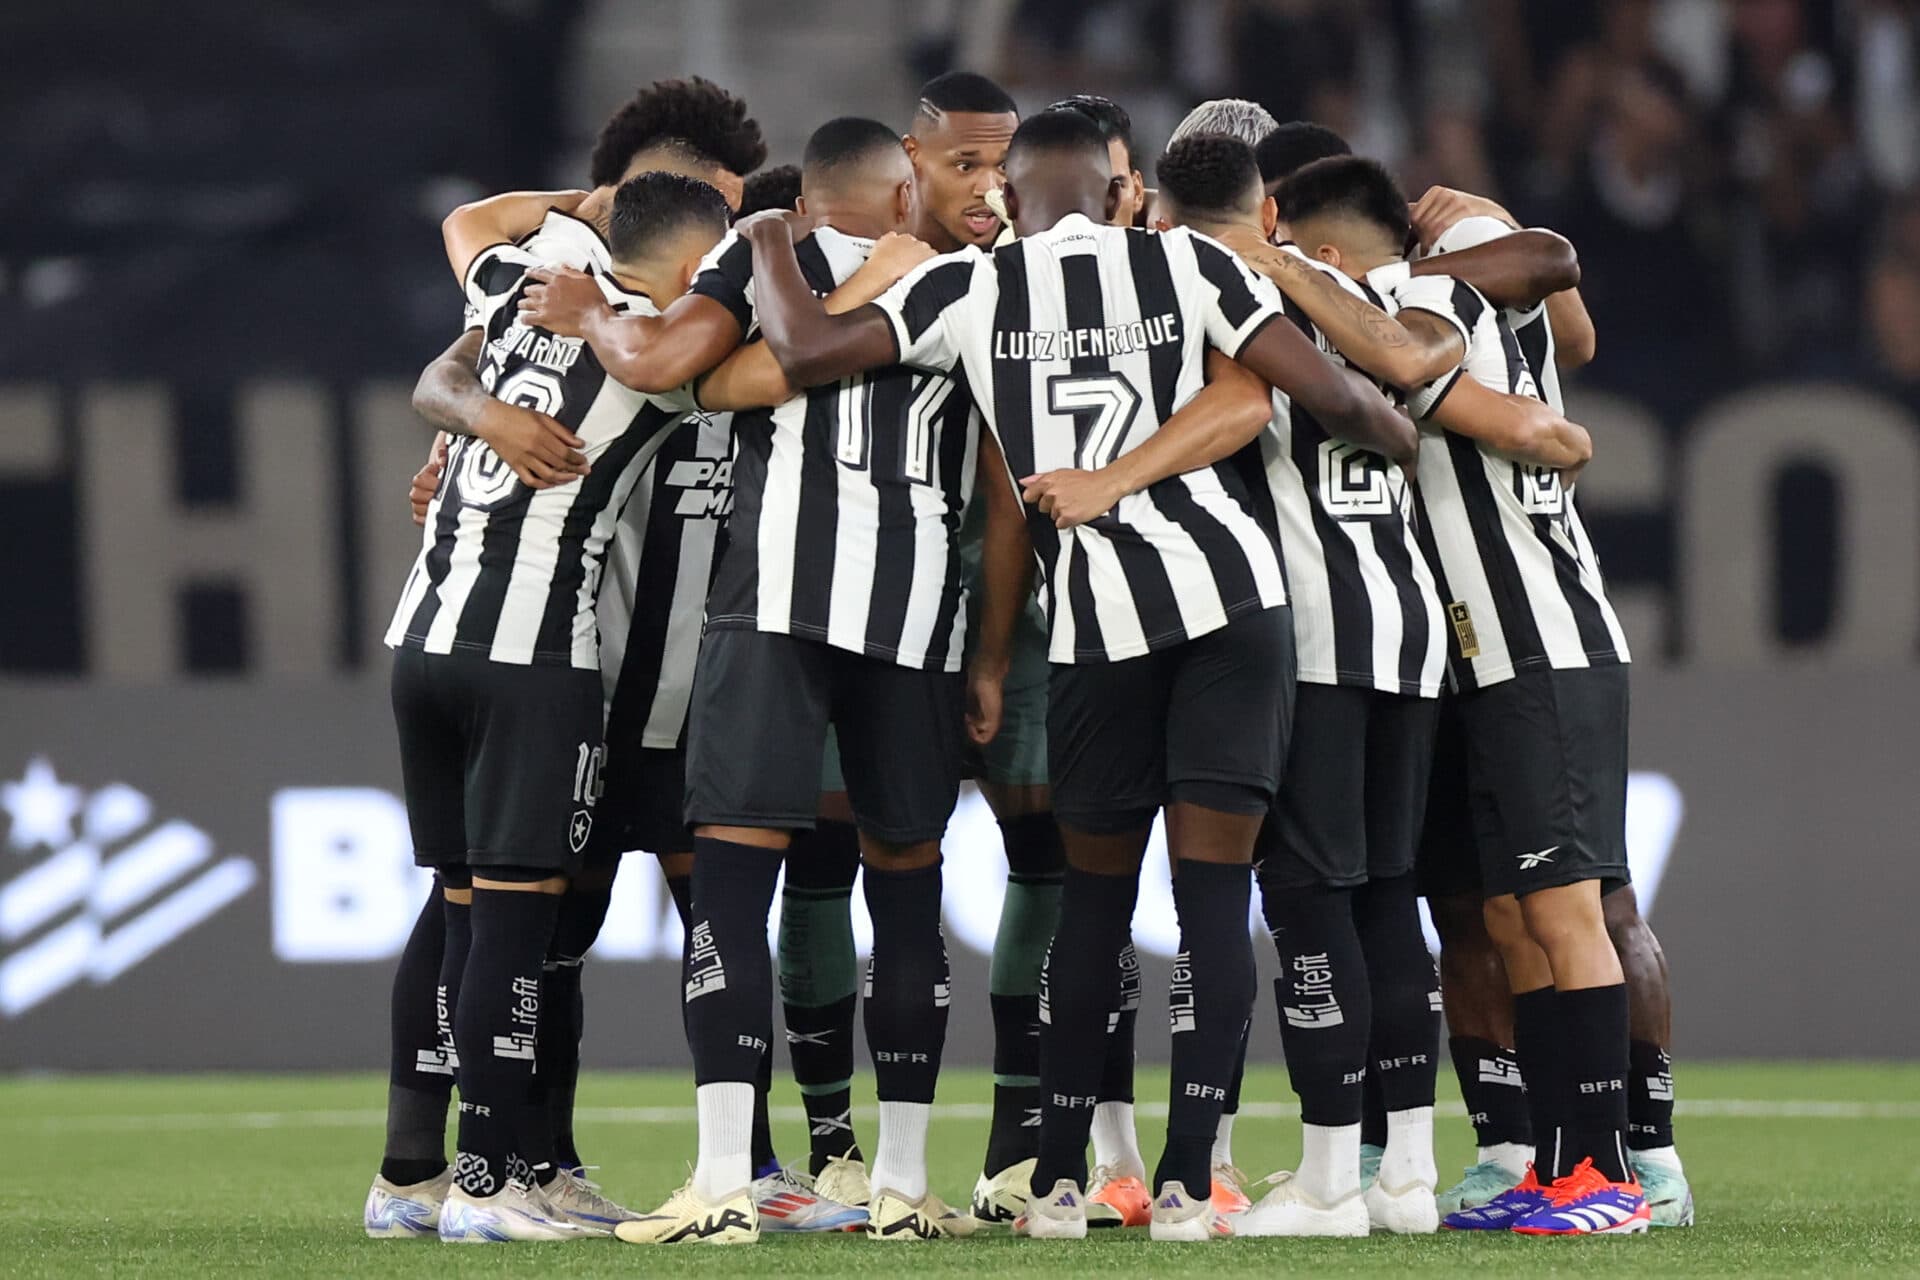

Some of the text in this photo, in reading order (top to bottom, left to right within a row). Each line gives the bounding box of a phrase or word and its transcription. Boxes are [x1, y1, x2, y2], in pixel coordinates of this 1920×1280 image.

[994, 312, 1180, 361] LUIZ HENRIQUE
[1046, 371, 1142, 471] 7
[573, 742, 608, 806] 10
[877, 1051, 928, 1063] BFR
[1379, 1054, 1427, 1070] BFR
[1184, 1082, 1226, 1102] BFR
[1580, 1079, 1623, 1094] BFR
[1053, 1093, 1097, 1109] BFR
